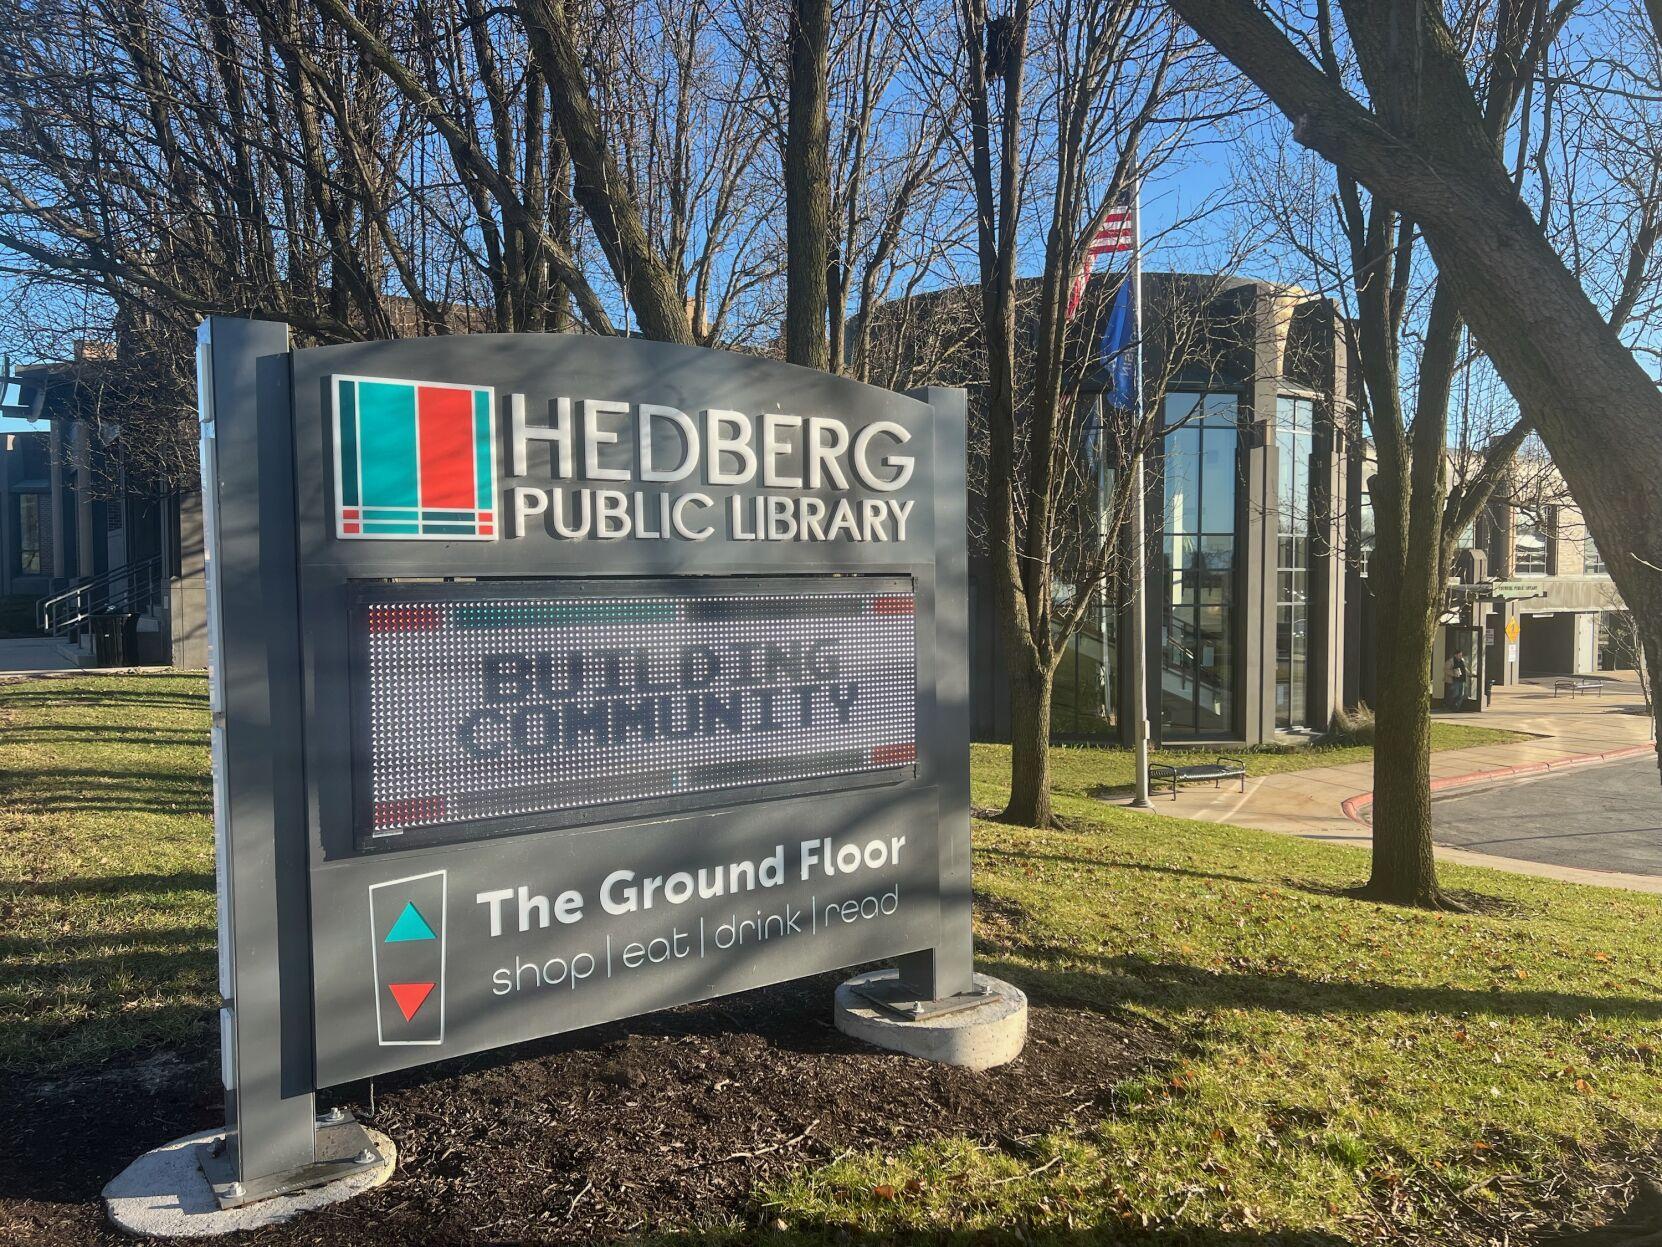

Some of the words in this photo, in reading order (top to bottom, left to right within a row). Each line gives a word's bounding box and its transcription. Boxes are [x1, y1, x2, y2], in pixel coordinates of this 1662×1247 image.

[511, 393, 915, 492] HEDBERG
[514, 486, 716, 540] PUBLIC
[732, 494, 915, 541] LIBRARY
[482, 640, 841, 698] BUILDING
[458, 682, 859, 758] COMMUNITY
[476, 885, 584, 937] The
[600, 844, 785, 916] Ground
[800, 835, 906, 881] Floor
[492, 952, 596, 996] shop
[622, 927, 690, 968] eat
[714, 903, 802, 949] drink
[825, 883, 899, 923] read
